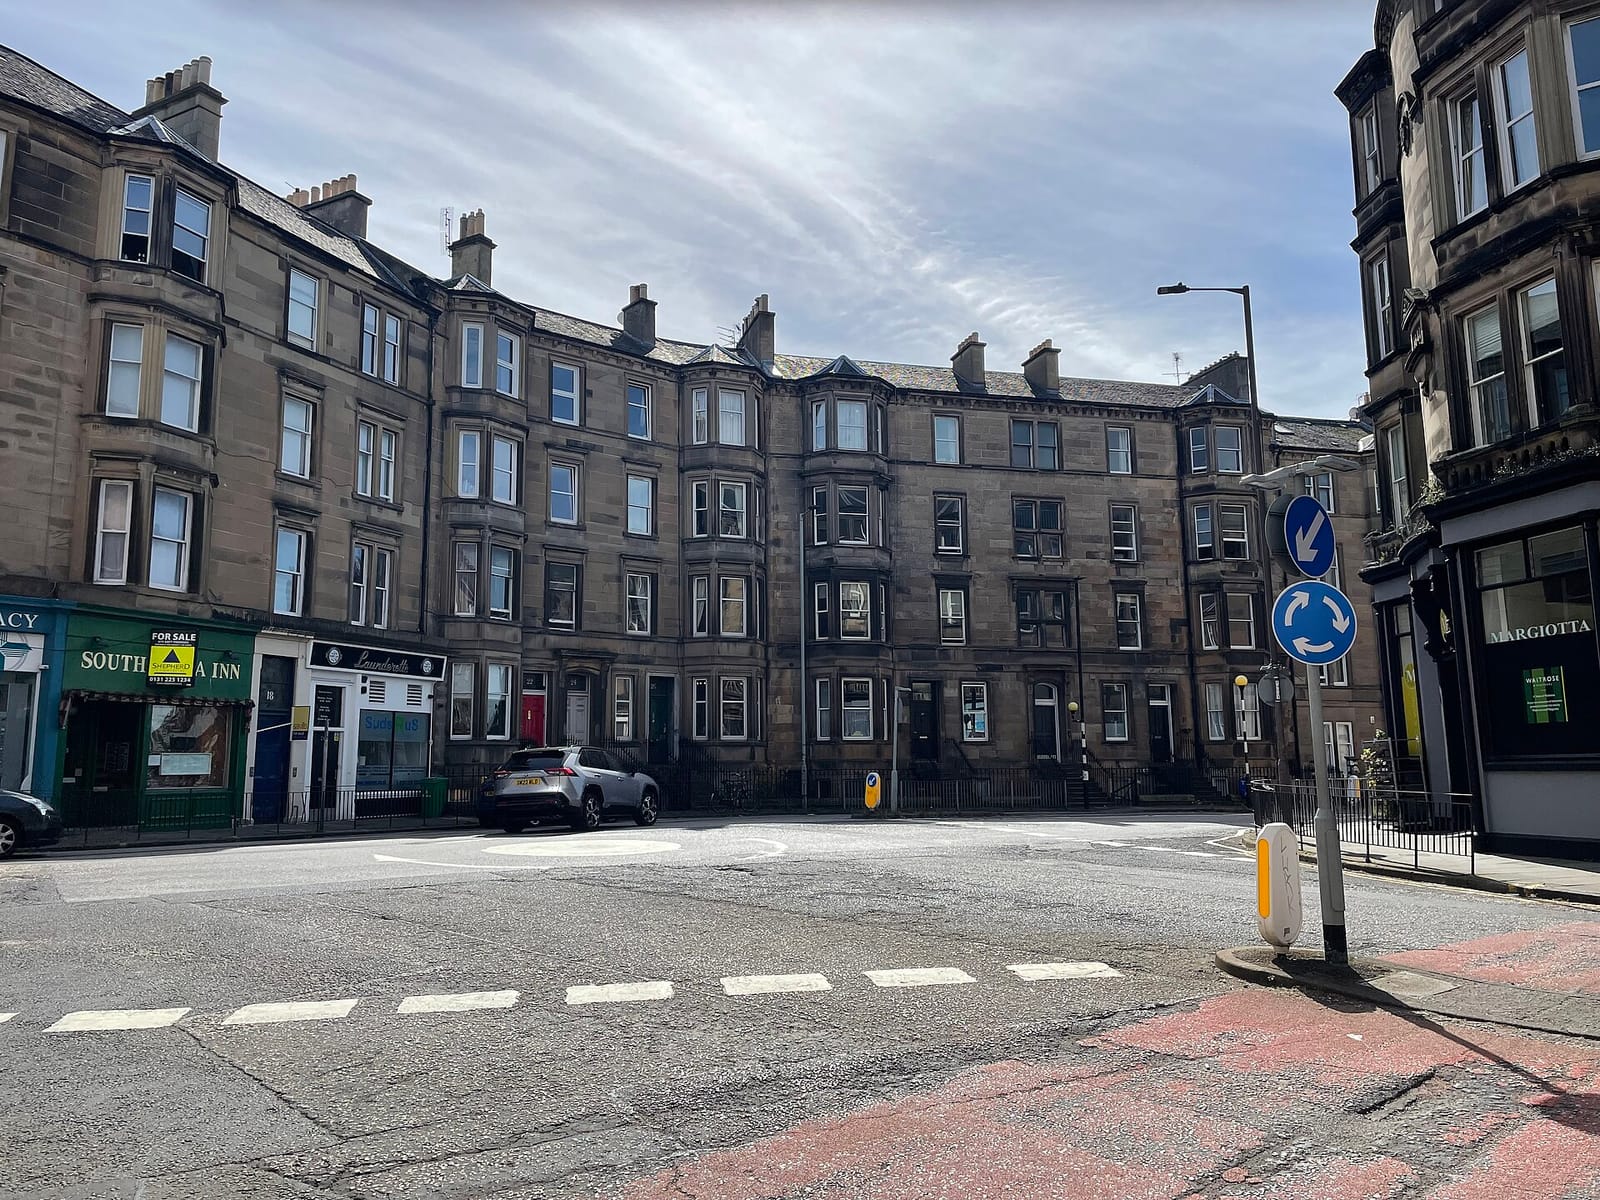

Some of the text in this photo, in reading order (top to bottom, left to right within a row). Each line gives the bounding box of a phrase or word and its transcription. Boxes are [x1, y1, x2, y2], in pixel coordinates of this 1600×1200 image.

[152, 632, 197, 642] FOR SALE
[1489, 619, 1592, 644] MARGIOTTA
[80, 650, 147, 673] SOUTH
[211, 662, 241, 680] INN
[152, 662, 191, 670] SHEPHERD
[353, 650, 409, 673] Launderette
[1525, 675, 1560, 684] WAITROSE
[266, 690, 274, 701] 18
[365, 715, 392, 730] Suds
